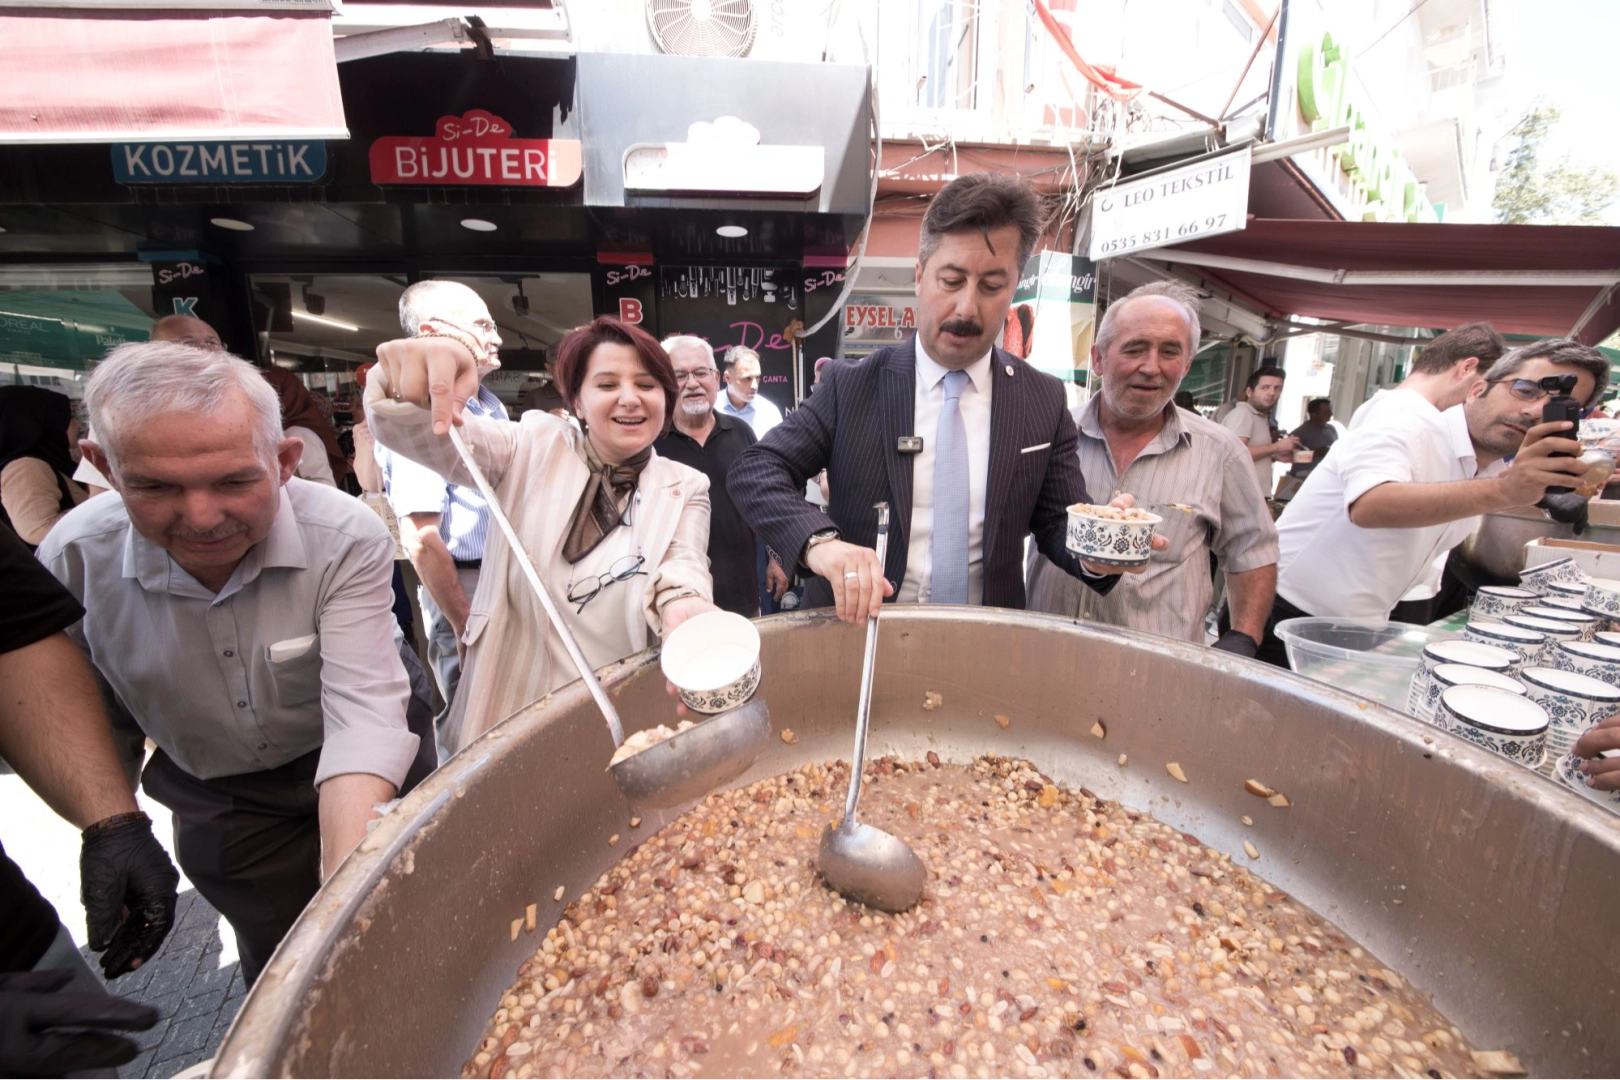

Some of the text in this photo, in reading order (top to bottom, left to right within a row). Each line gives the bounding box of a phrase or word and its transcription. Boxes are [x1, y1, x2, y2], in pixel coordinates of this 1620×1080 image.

[442, 117, 505, 141] Si-De
[1124, 163, 1234, 208] LEO TEKSTİL
[1101, 213, 1227, 253] 0535 831 66 97
[158, 262, 204, 284] Si-De
[606, 264, 651, 285] Si-De
[804, 270, 846, 292] Si-De
[172, 297, 200, 320] K
[619, 298, 643, 325] B
[762, 375, 788, 384] ÇANTA
